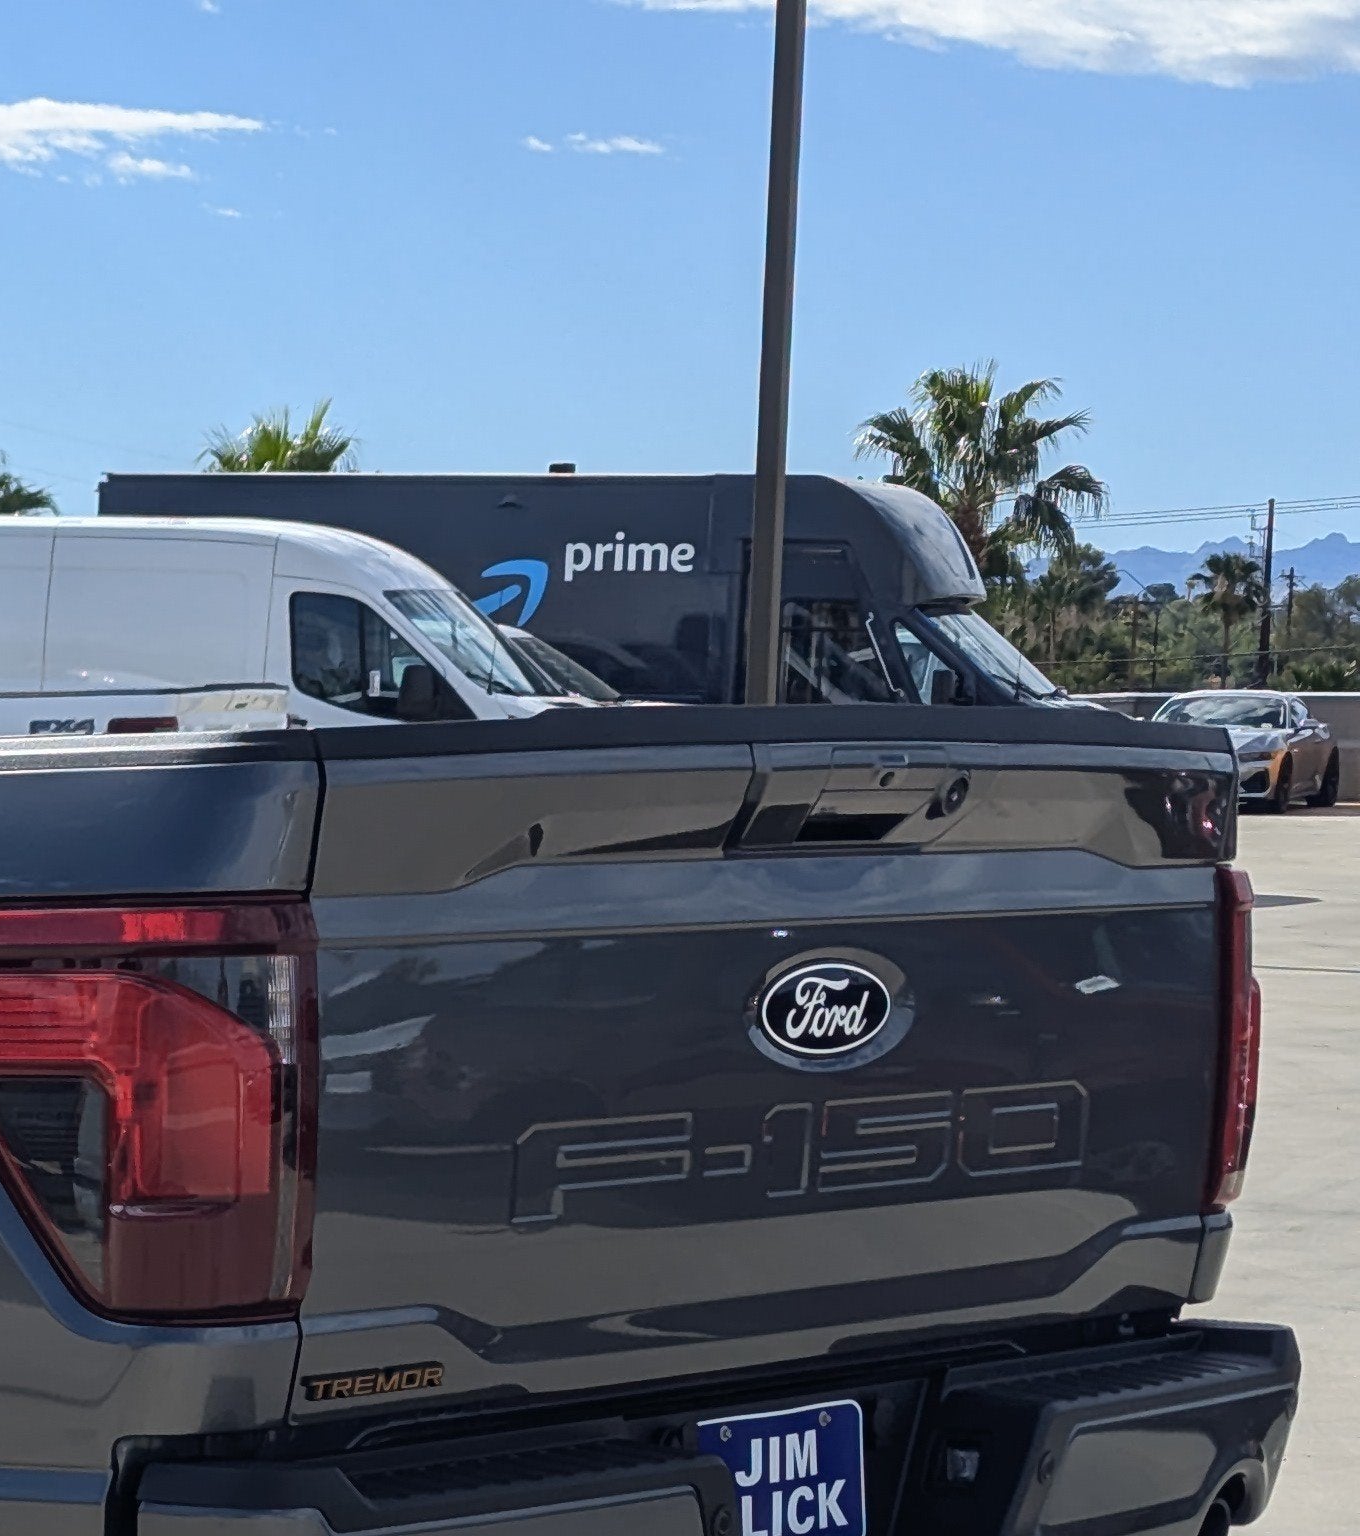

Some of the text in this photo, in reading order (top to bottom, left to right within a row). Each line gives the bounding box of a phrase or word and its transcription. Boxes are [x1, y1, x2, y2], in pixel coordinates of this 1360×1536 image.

[563, 530, 696, 582] prime
[785, 976, 870, 1039] Ford
[510, 1079, 1089, 1224] F-150
[312, 1366, 445, 1400] TREMOR
[734, 1428, 819, 1488] JIM
